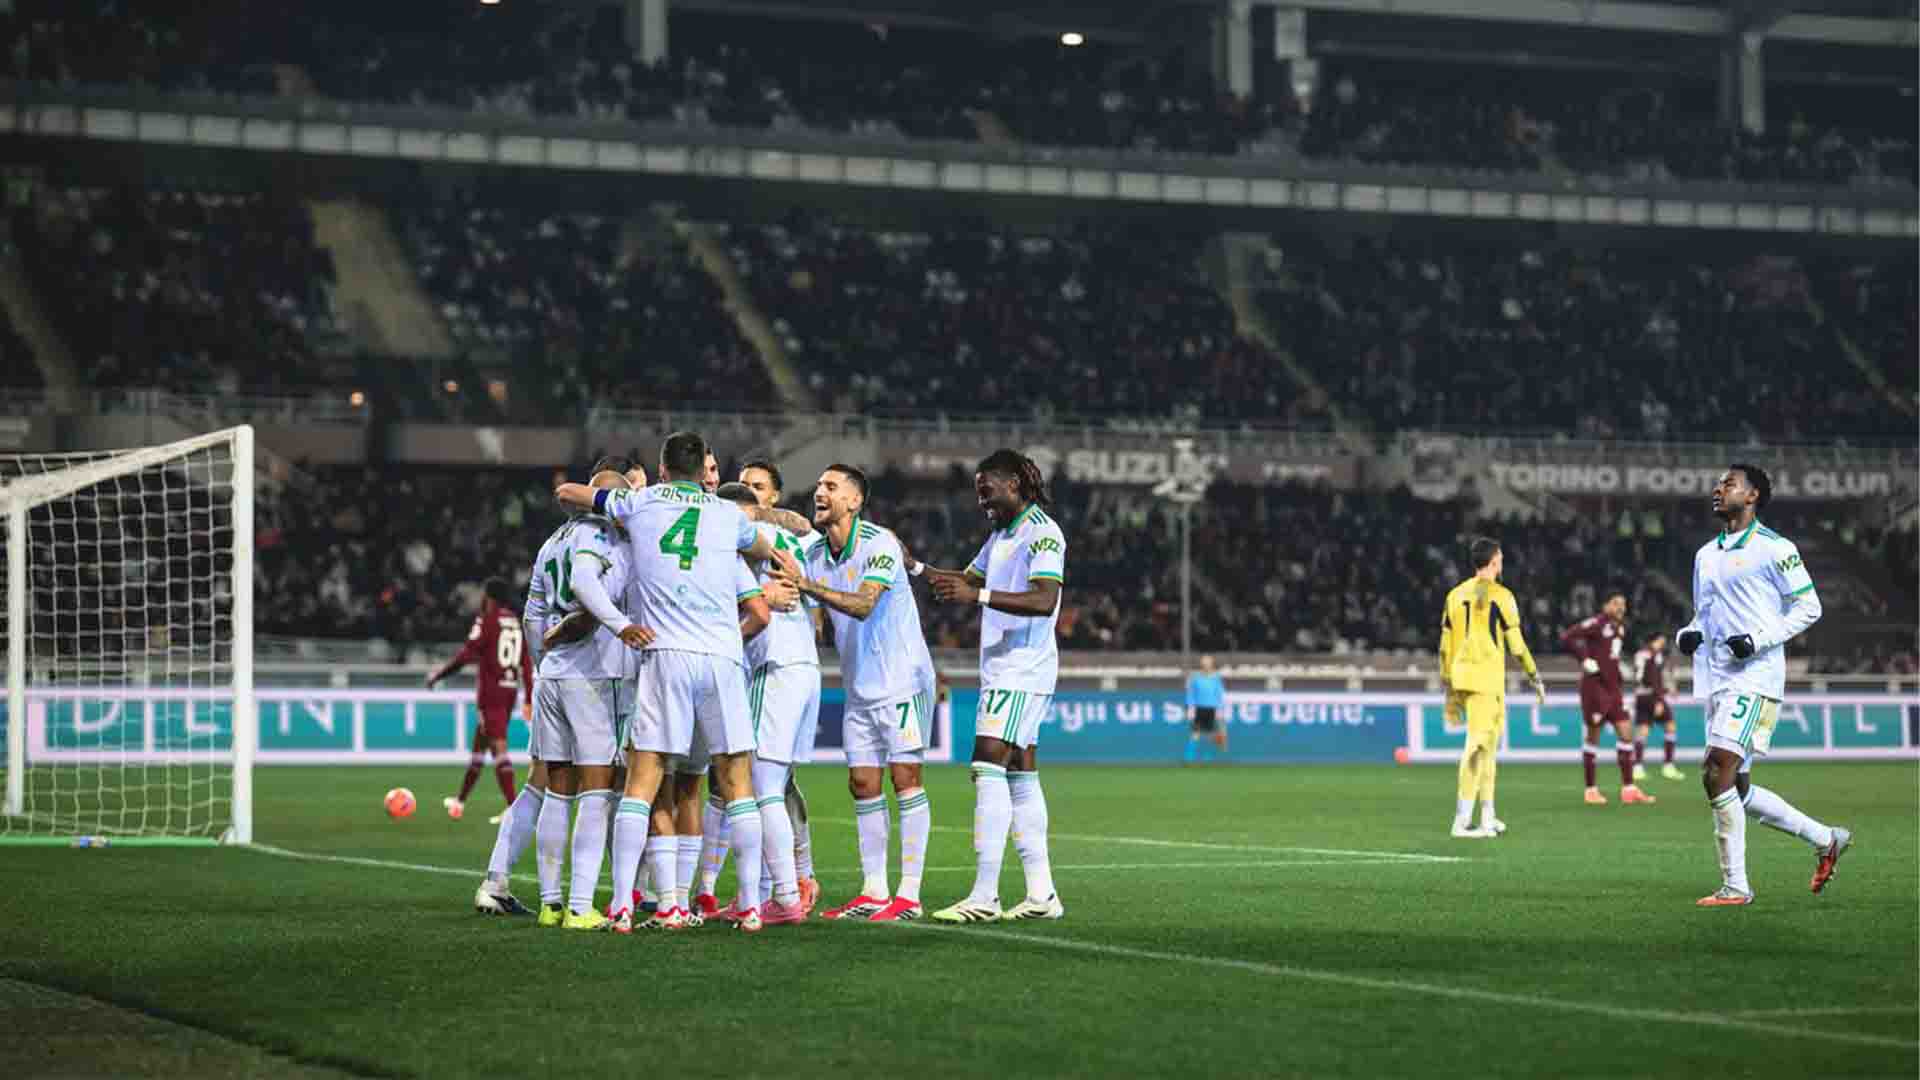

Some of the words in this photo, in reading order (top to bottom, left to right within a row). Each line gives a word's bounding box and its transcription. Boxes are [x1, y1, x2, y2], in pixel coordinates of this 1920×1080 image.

[1488, 463, 1619, 491] TORINO
[1626, 466, 1799, 495] FOOTL
[658, 506, 702, 571] 4
[896, 702, 910, 729] 7
[986, 689, 1012, 715] 17
[1732, 695, 1749, 719] 5
